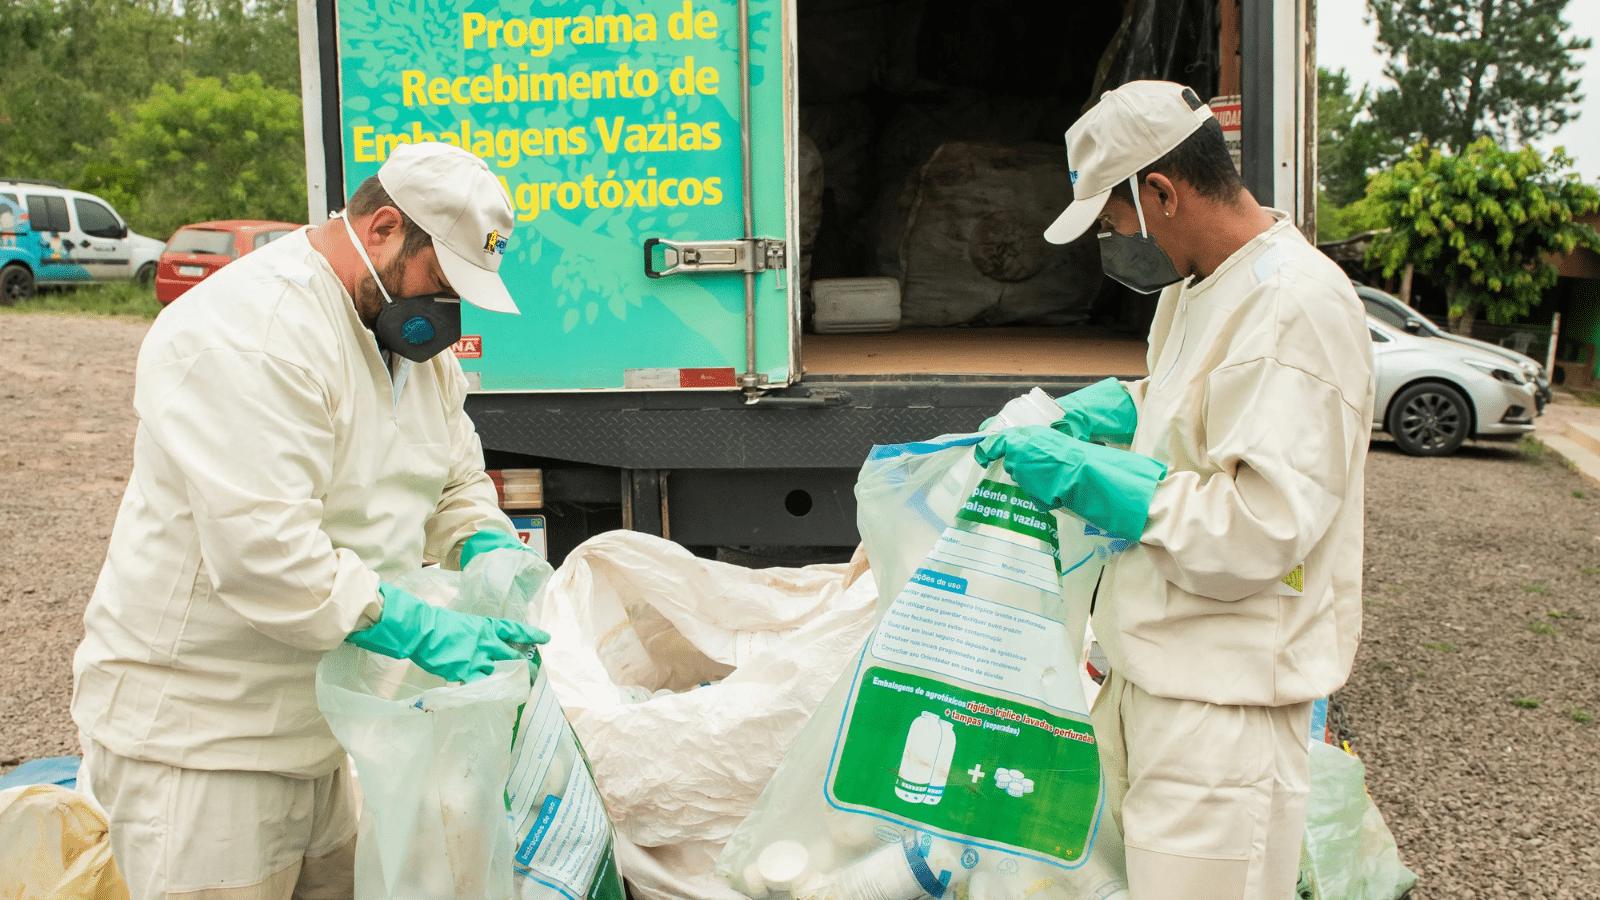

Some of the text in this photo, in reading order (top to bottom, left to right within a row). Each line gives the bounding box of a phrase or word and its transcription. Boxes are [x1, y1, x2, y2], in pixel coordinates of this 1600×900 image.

[464, 0, 718, 57] Programa de
[403, 56, 719, 106] Recebimento de
[596, 113, 721, 154] Vazias
[1013, 513, 1046, 530] vazias
[936, 577, 946, 585] de
[947, 581, 963, 590] uso:
[925, 605, 938, 613] para
[939, 609, 961, 619] guardar
[961, 615, 986, 626] qualquer
[987, 621, 1002, 630] outro
[940, 596, 974, 610] embalagens
[887, 620, 910, 631] Guardar
[921, 628, 934, 637] local
[934, 633, 955, 643] seguro
[963, 640, 988, 652] depósito
[910, 613, 933, 624] fechado
[933, 620, 946, 628] para
[947, 623, 963, 631] evitar
[964, 628, 1002, 643] contaminação
[880, 643, 908, 655] Consultar
[920, 653, 950, 665] Orientador
[983, 670, 1003, 680] dúvidas
[884, 632, 909, 643] Devolver
[920, 641, 937, 650] locais
[938, 646, 976, 661] programados
[976, 656, 989, 665] para
[872, 677, 914, 693] Embalagens
[915, 686, 925, 695] de
[925, 690, 967, 708] agrotóxicos
[966, 700, 994, 716] rígidas
[1022, 714, 1053, 732] lavadas
[1053, 727, 1095, 744] perfuradas
[951, 711, 982, 727] tampas
[983, 719, 1020, 737] (separadas)
[522, 825, 544, 860] Instruções
[542, 815, 550, 824] de
